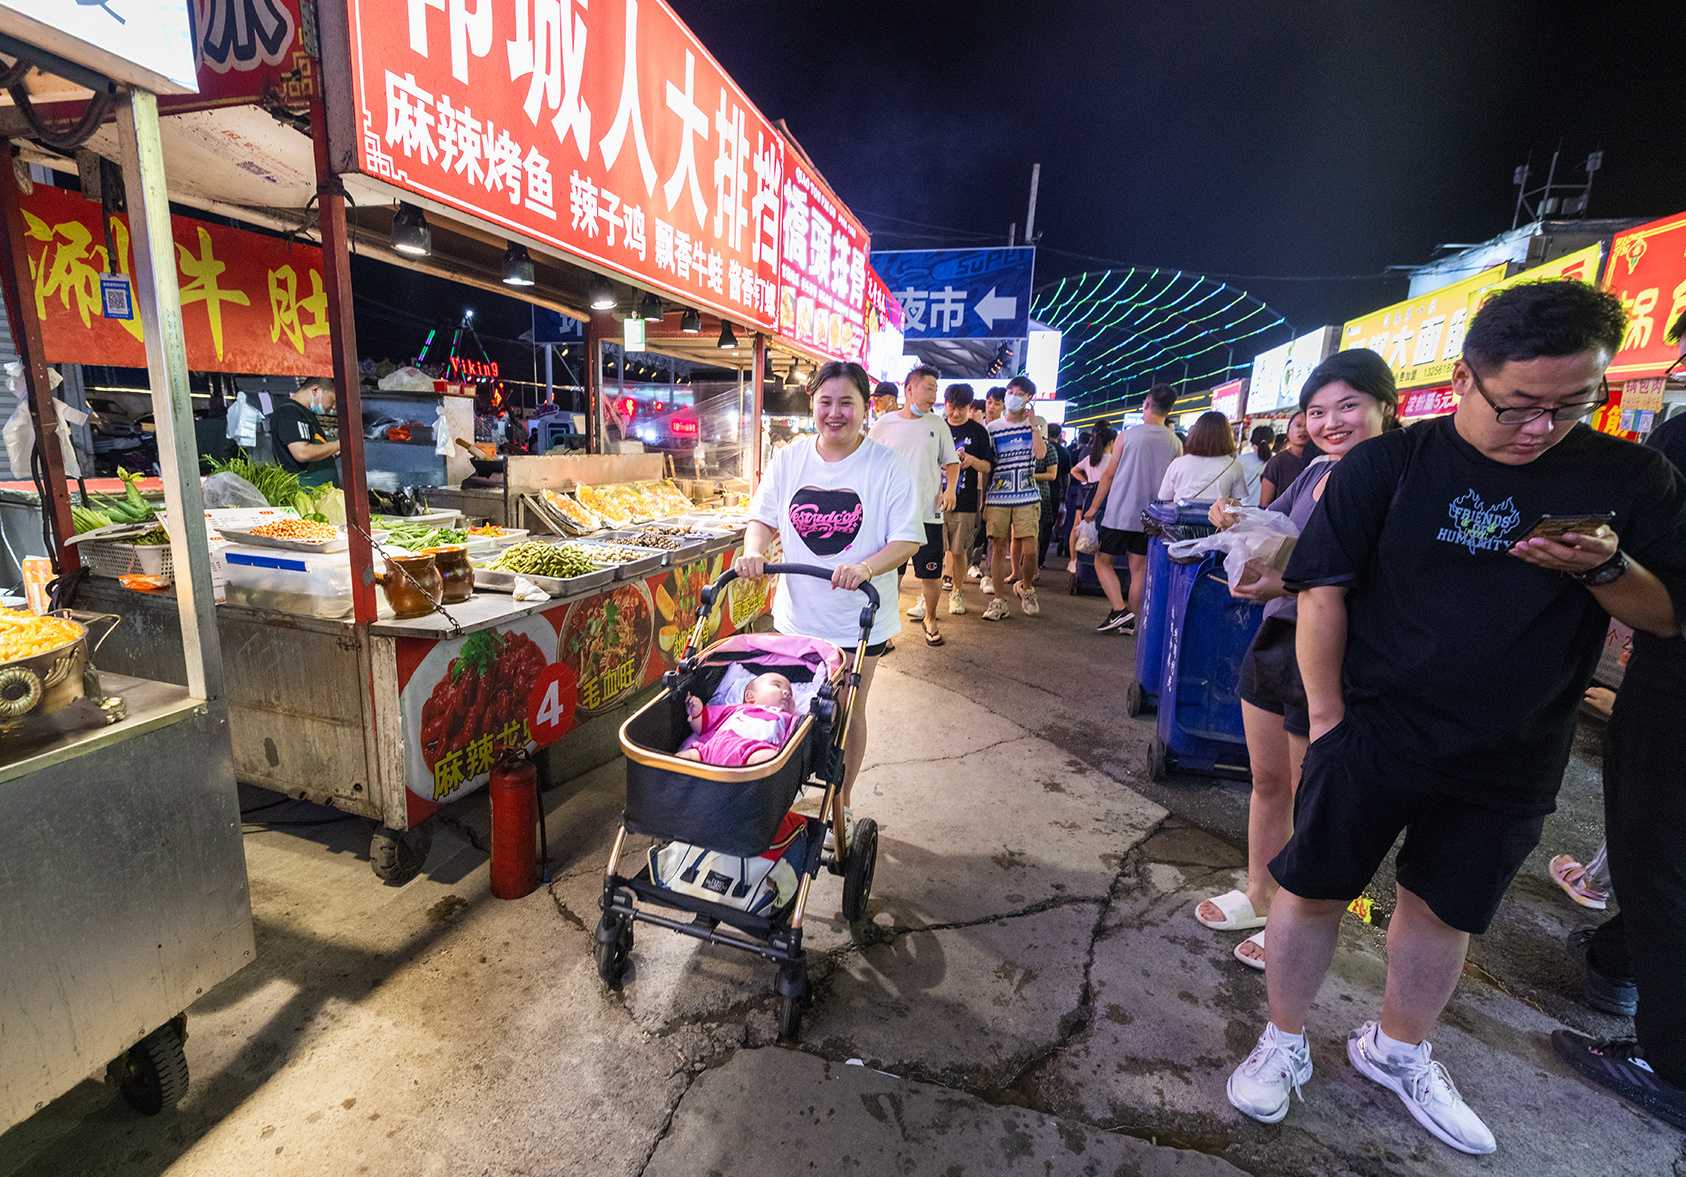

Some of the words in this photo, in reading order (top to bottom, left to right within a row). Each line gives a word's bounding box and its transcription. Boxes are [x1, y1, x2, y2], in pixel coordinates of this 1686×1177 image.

[384, 69, 557, 221] 麻辣烤鱼
[569, 169, 646, 262] 辣子鸡
[655, 216, 723, 295] 飘香牛蛙
[21, 208, 331, 362] 涮牛肚
[892, 286, 967, 333] 夜市
[450, 356, 499, 378] Viking
[1454, 506, 1511, 528] FRIENDS
[536, 679, 564, 728] 4
[582, 658, 635, 710] 毛血旺
